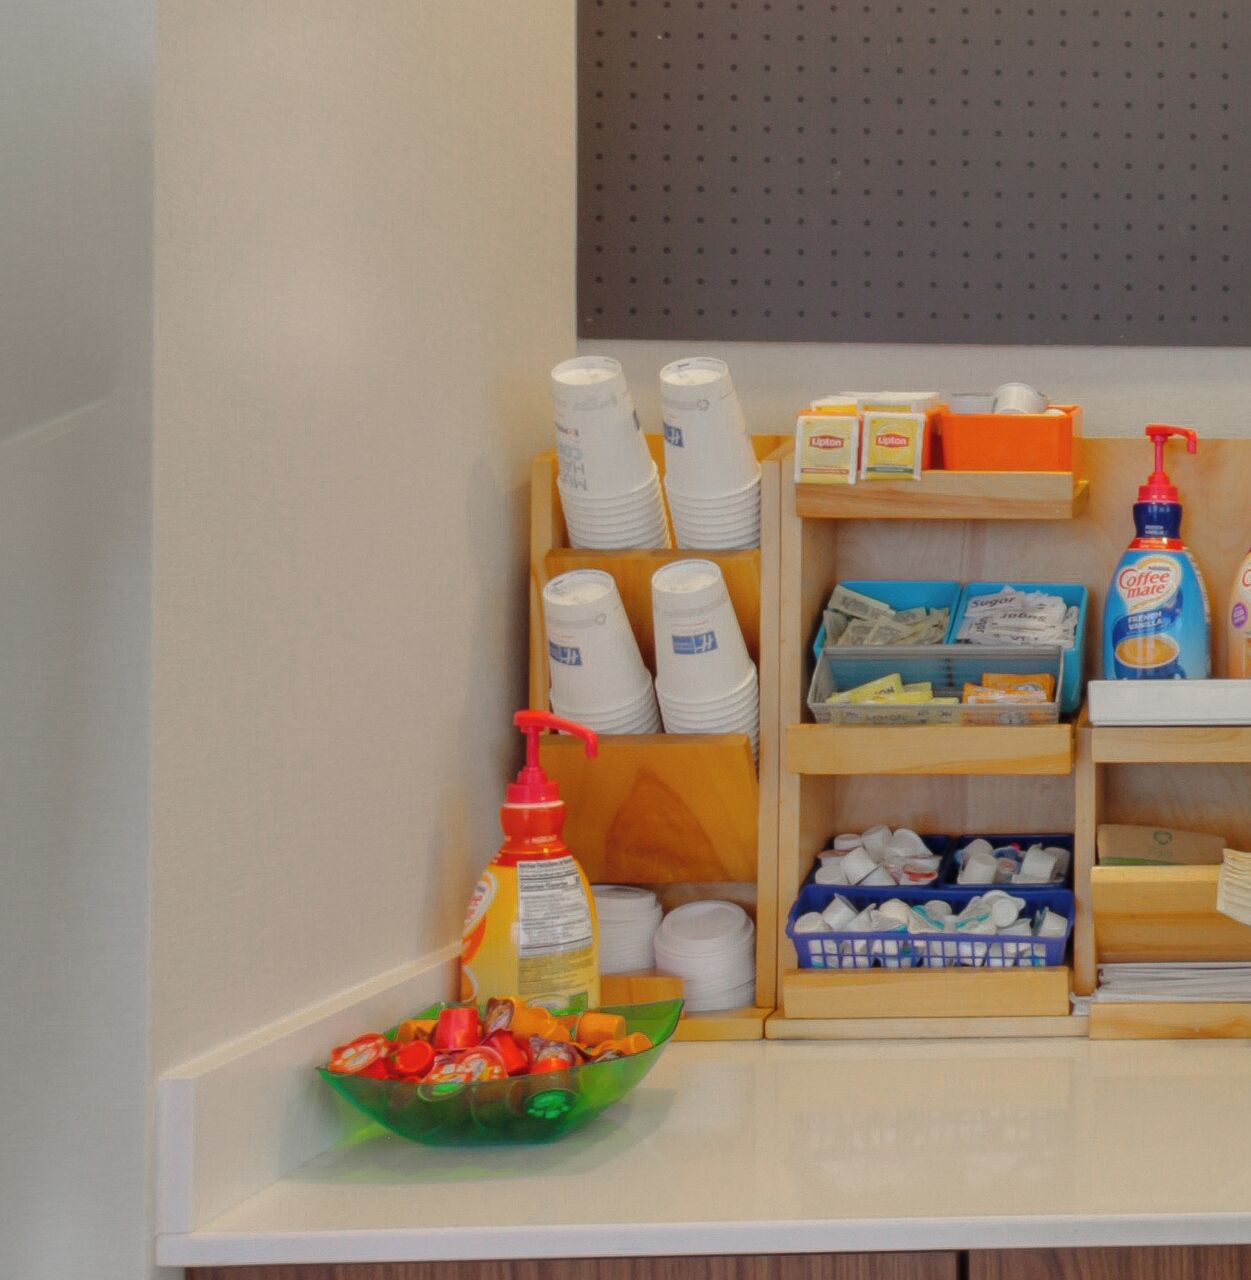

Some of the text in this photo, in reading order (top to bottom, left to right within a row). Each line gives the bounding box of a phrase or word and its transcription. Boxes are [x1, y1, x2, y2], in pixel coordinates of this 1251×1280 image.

[811, 436, 842, 448] Lipton
[878, 435, 907, 446] Lipton
[1119, 567, 1170, 590] Coffee
[1127, 583, 1166, 599] mate
[970, 596, 1017, 609] Sugar
